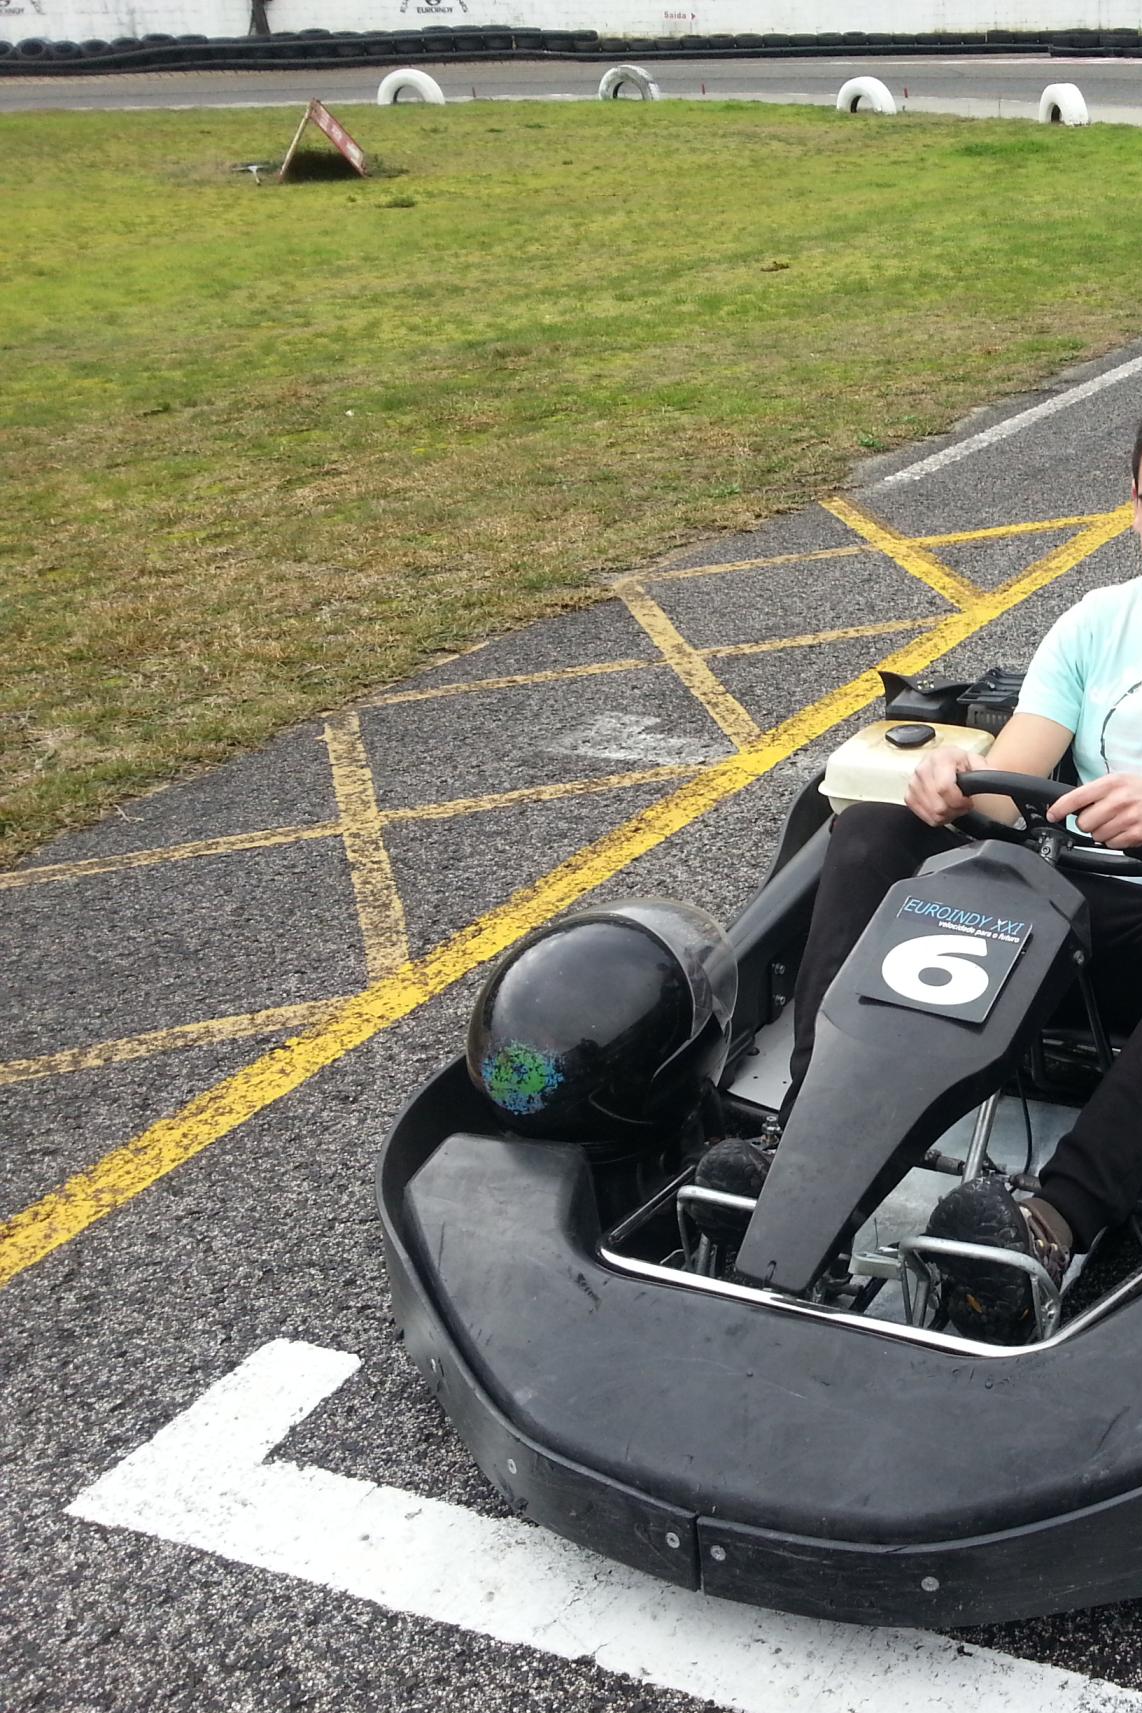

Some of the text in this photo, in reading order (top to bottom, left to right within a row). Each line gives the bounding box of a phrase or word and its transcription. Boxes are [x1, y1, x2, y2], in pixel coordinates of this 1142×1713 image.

[904, 899, 1025, 935] EUROINDY XXI
[938, 920, 976, 935] velocidade
[974, 929, 992, 938] para
[998, 933, 1020, 943] futuro
[881, 934, 989, 1006] 6
